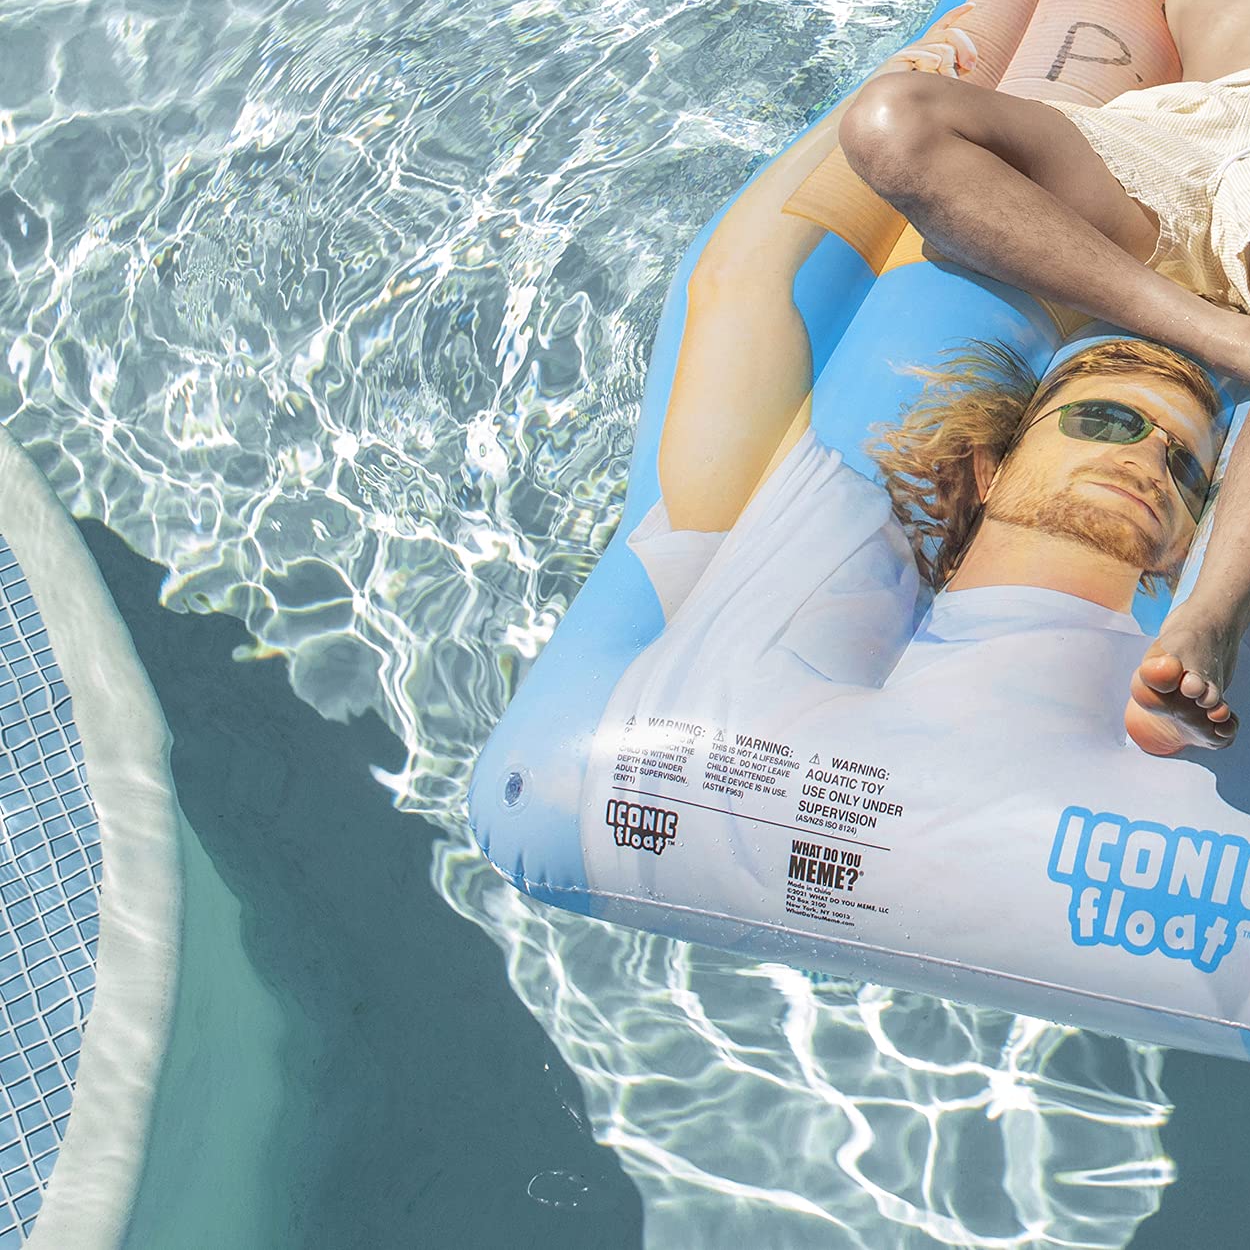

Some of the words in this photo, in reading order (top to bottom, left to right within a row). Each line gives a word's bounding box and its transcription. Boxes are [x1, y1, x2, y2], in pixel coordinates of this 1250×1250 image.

[648, 717, 706, 738] WARNING:
[650, 750, 674, 761] WITHIN
[676, 755, 687, 764] ITS
[681, 746, 695, 756] THE
[711, 743, 728, 752] THIS
[737, 749, 752, 758] NOT
[752, 752, 758, 760] A
[759, 754, 800, 770] LIFESAVING
[735, 734, 794, 758] WARNING:
[615, 764, 638, 773] ADULT
[640, 767, 688, 784] SUPERVISION.
[617, 754, 640, 764] DEPTH
[642, 758, 657, 767] AND
[658, 762, 683, 773] UNDER
[706, 762, 728, 773] CHILD
[729, 767, 776, 785] UNATTENDED
[739, 760, 751, 768] DO
[752, 763, 767, 772] NOT
[767, 767, 791, 778] LEAVE
[831, 757, 890, 780] WARNING:
[613, 773, 635, 784] (EN71)
[702, 781, 725, 793] (ASTM
[704, 772, 727, 783] WHILE
[728, 777, 753, 790] DEVICE
[755, 784, 762, 792] IS
[763, 786, 770, 794] IN
[771, 788, 787, 798] USE.
[805, 768, 858, 790] AQUATIC
[861, 781, 885, 795] TOY
[802, 783, 827, 799] USE
[828, 790, 861, 807] ONLY
[862, 798, 904, 817] UNDER
[607, 800, 678, 838] ICONIC
[795, 814, 824, 826] (AS/NZS
[825, 820, 838, 830] ISO
[838, 823, 857, 835] 8124)
[798, 800, 877, 828] SUPERVISION
[614, 825, 665, 854] float
[792, 840, 823, 859] WHAT
[823, 847, 839, 863] DO
[840, 851, 862, 868] YOU
[788, 854, 859, 891] MEME?
[787, 880, 805, 890] Made
[786, 901, 801, 909] New
[809, 893, 828, 902] WHAT
[841, 899, 856, 908] YOU
[879, 906, 889, 914] LLC
[1076, 886, 1230, 965] float
